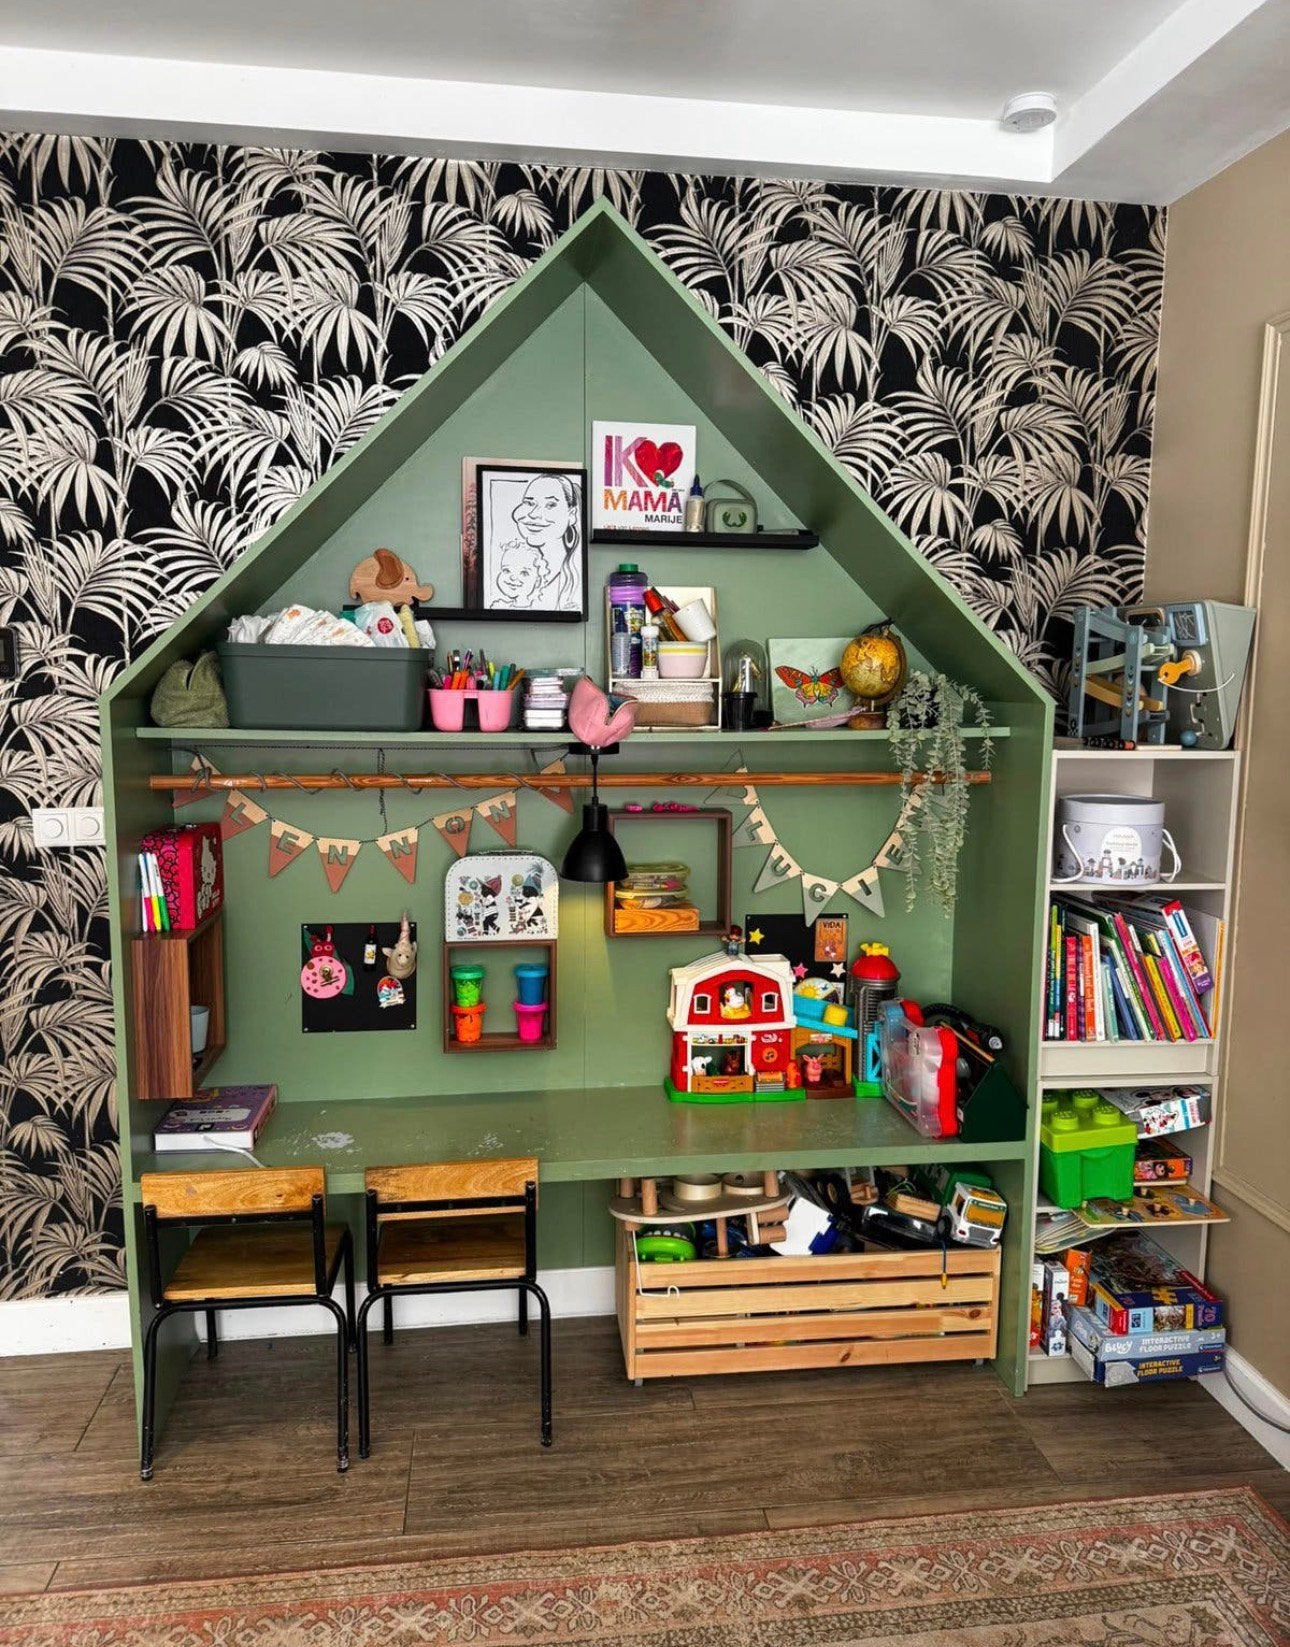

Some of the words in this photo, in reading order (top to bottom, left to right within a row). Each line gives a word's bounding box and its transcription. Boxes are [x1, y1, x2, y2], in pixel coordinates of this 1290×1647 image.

[604, 434, 649, 488] IK
[603, 488, 683, 514] MAMA
[644, 514, 683, 524] MARIJE
[1138, 1359, 1181, 1370] INTERACTIVE
[1137, 1368, 1159, 1377] FLOOR
[1159, 1366, 1183, 1375] PUZZLE
